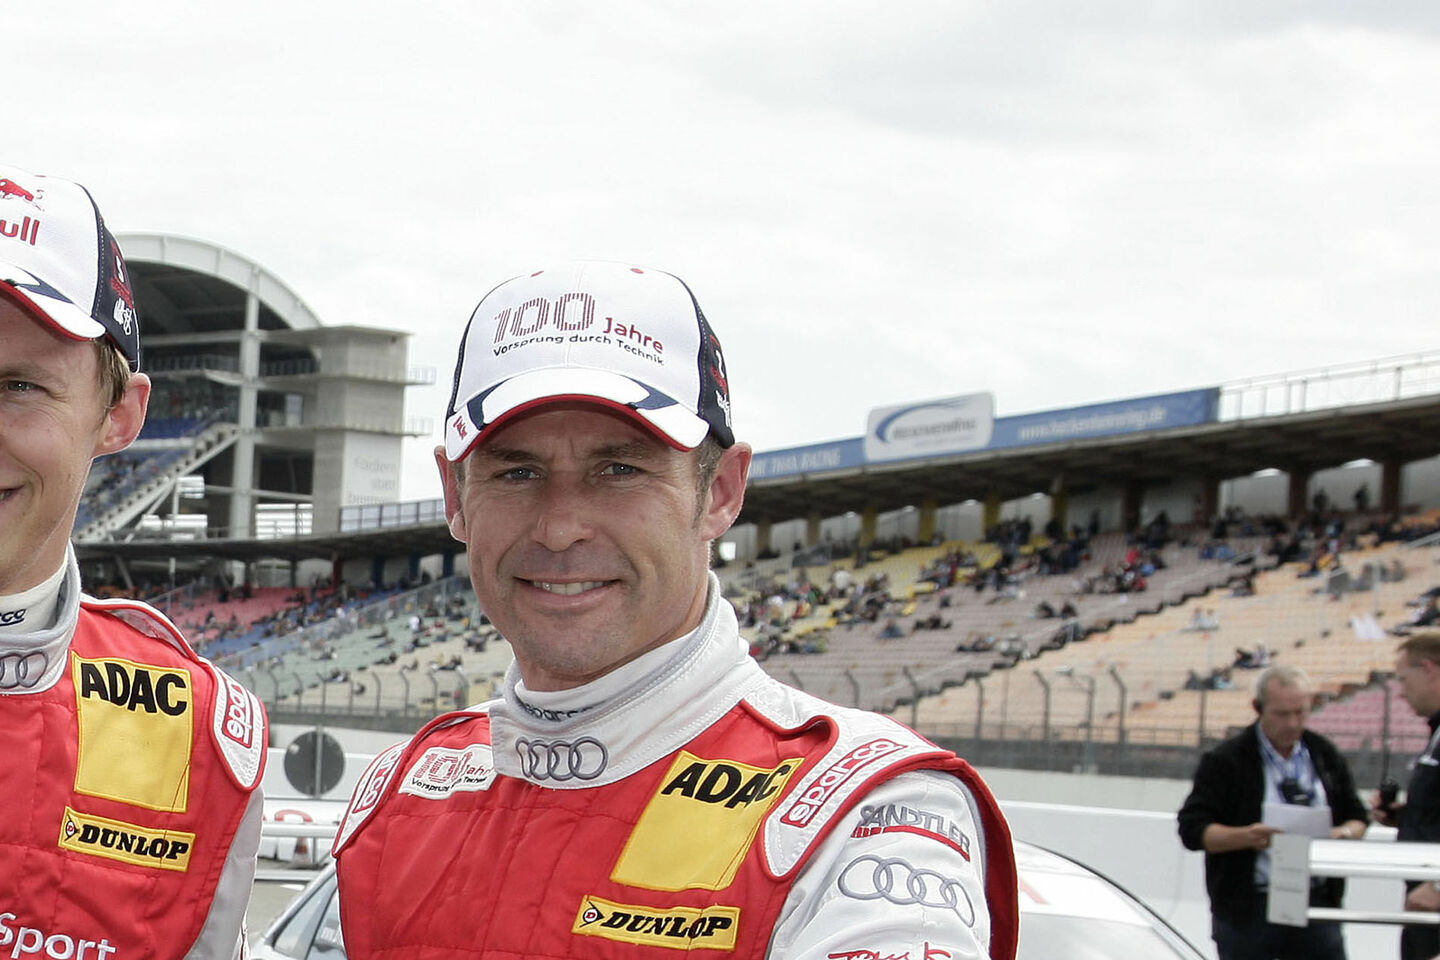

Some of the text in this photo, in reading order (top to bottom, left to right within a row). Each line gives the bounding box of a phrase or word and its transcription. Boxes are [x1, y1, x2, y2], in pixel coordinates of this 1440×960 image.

[493, 292, 664, 354] 100 Jahre
[493, 333, 665, 365] Vorsprung durch Technik
[80, 662, 189, 717] ADAC
[661, 762, 791, 810] ADAC
[78, 822, 190, 861] DUNLOP
[859, 803, 971, 855] SANDTLER
[601, 911, 733, 940] DUNLOP
